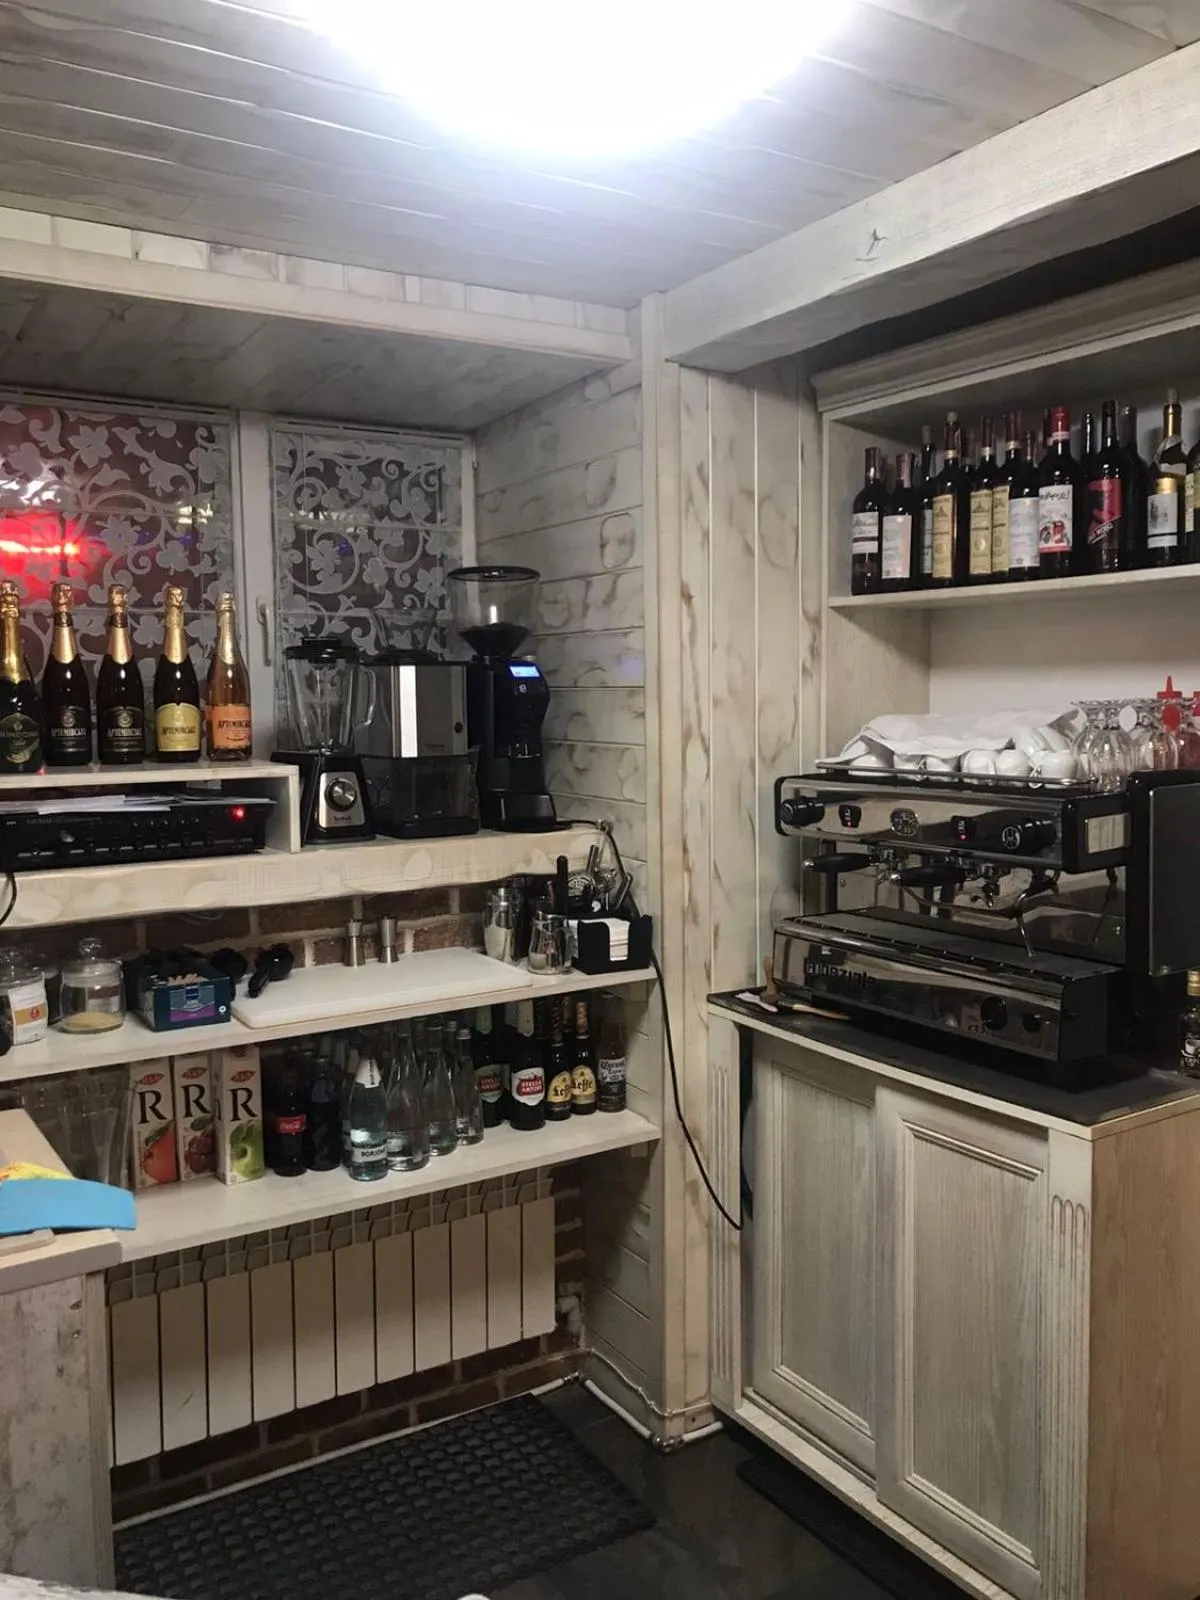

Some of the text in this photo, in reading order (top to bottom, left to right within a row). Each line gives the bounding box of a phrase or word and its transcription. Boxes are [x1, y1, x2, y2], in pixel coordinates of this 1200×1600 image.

[138, 1089, 168, 1125] R
[182, 1083, 211, 1118] R
[229, 1087, 258, 1122] R
